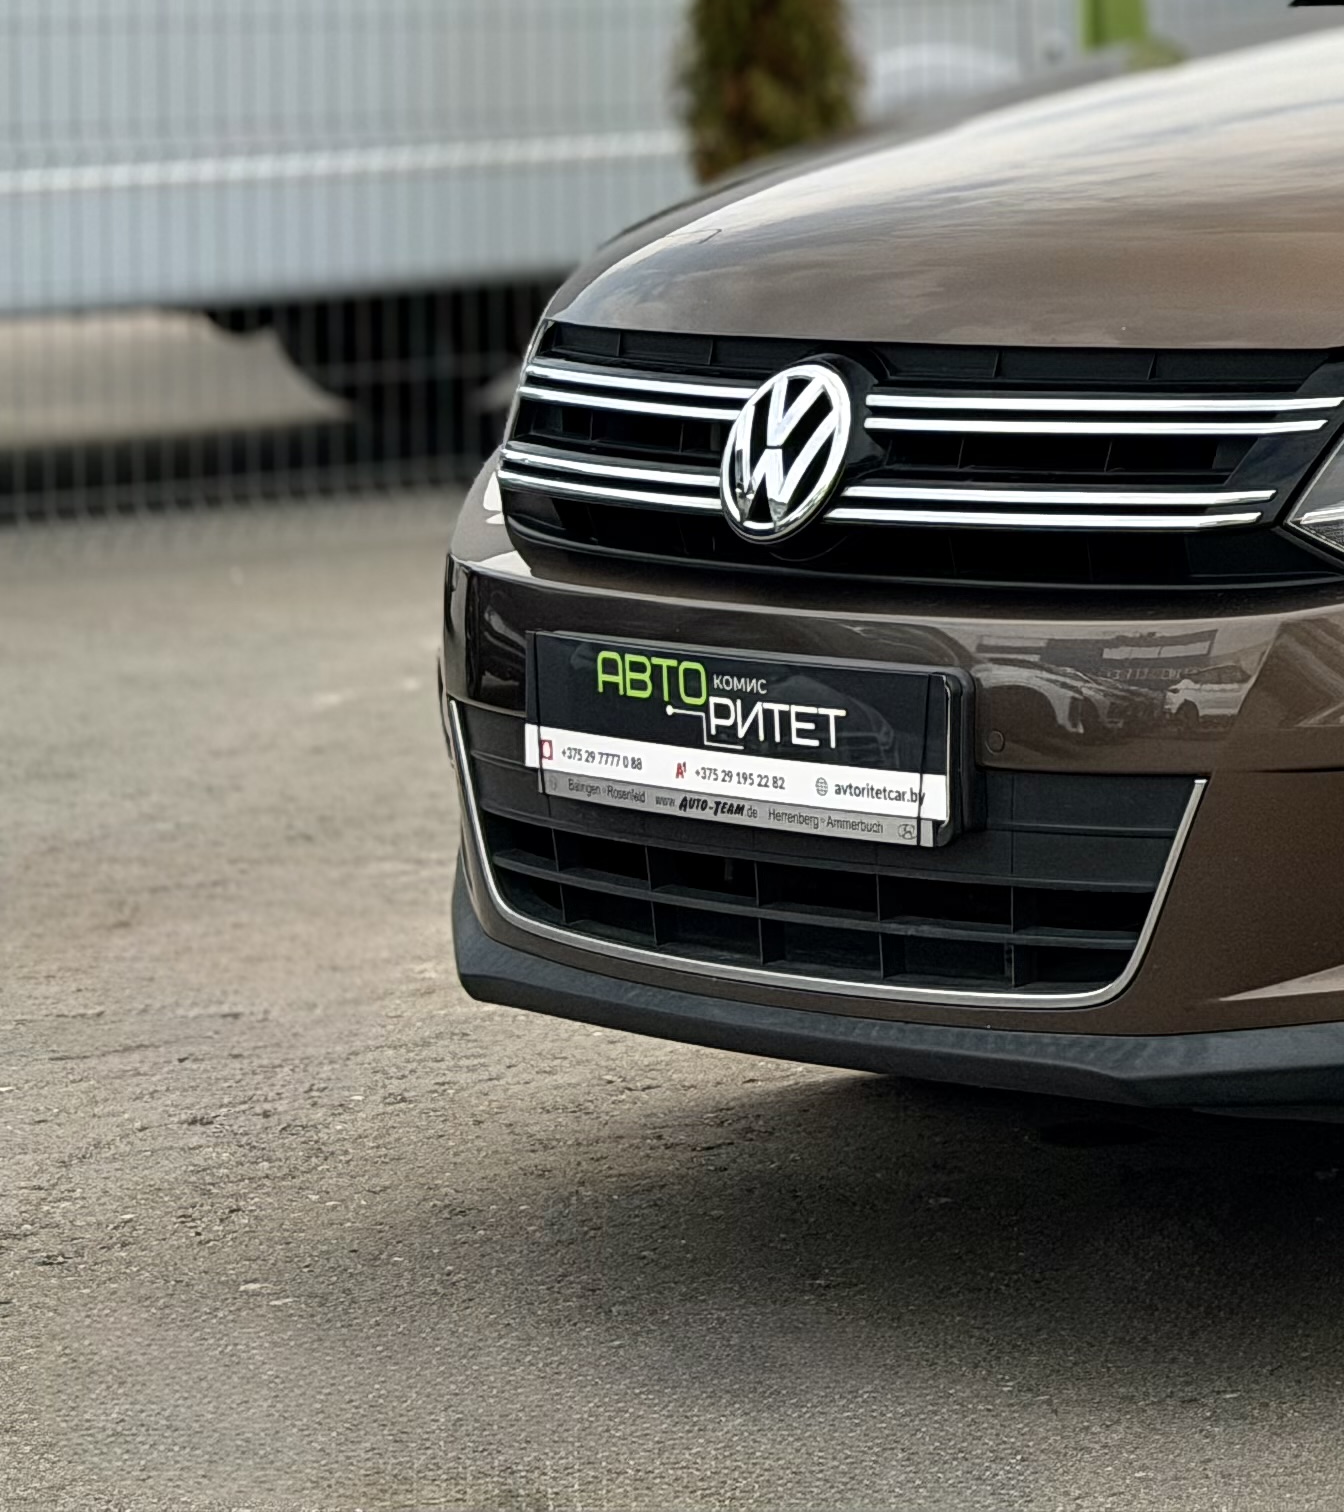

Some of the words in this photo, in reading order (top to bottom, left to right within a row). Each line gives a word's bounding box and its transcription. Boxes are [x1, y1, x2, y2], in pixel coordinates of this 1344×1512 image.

[597, 650, 707, 705] АВТО
[708, 696, 847, 749] РИТЕТ
[695, 766, 719, 782] +375
[721, 769, 733, 783] 29
[736, 771, 755, 786] 195
[756, 774, 770, 788] 22
[772, 775, 786, 790] 82
[834, 782, 926, 807] avtoritetcar.by
